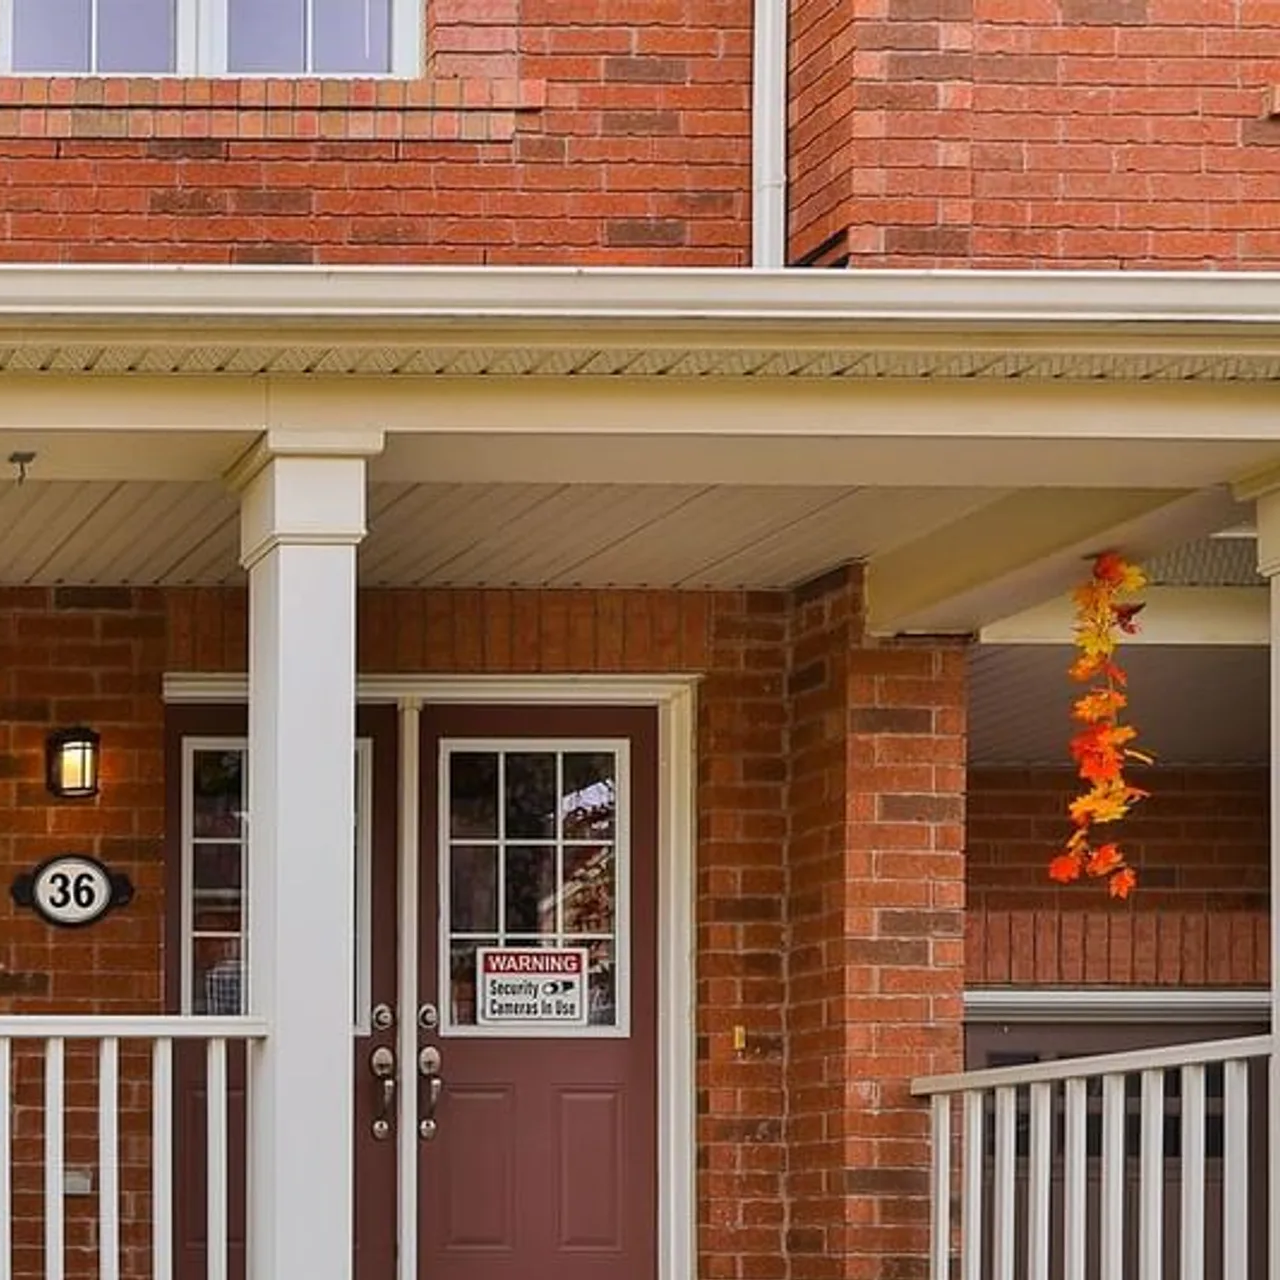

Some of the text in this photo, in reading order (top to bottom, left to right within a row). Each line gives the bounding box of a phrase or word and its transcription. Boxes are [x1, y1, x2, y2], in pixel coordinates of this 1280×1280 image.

[49, 873, 95, 908] 36
[488, 955, 578, 971] WARNING
[490, 979, 539, 999] Security
[490, 999, 575, 1015] Cameras In Use
